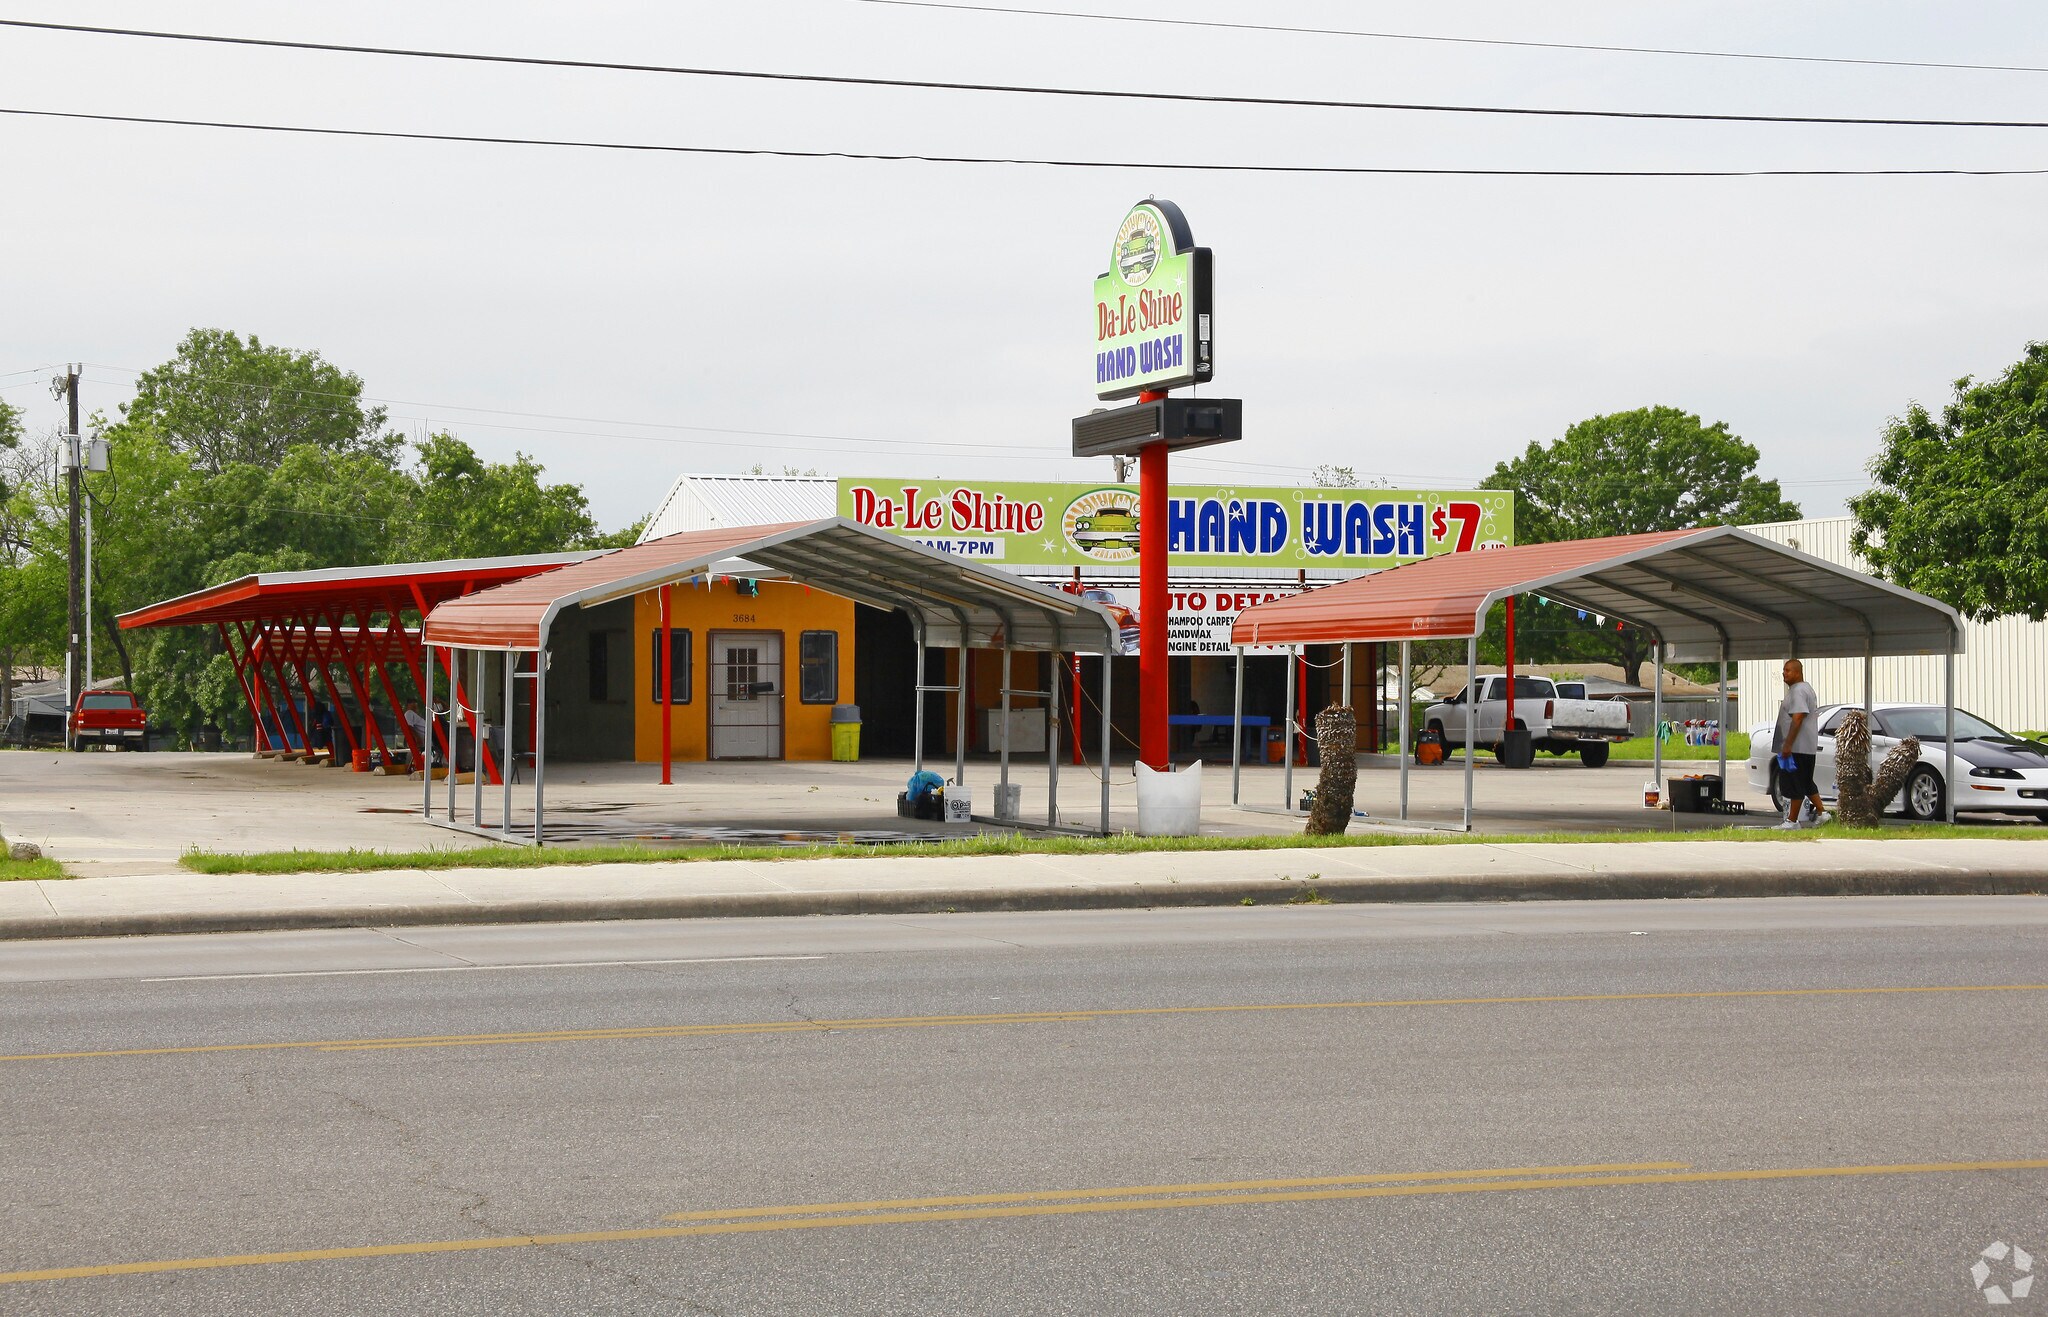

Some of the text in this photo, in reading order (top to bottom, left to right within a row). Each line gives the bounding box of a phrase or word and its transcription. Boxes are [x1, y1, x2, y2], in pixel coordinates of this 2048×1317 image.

[1097, 294, 1136, 341] Da-Le
[1139, 287, 1183, 332] Shine
[1096, 333, 1183, 384] HAND WASH
[851, 487, 1043, 534] Da-Le Shine
[1168, 499, 1481, 556] HAND WASH $7
[914, 539, 994, 555] M-7PM
[1216, 593, 1296, 612] DET
[733, 614, 756, 623] 3684
[1168, 616, 1204, 626] HAMPOO
[1168, 642, 1231, 652] NGINE DETAIL
